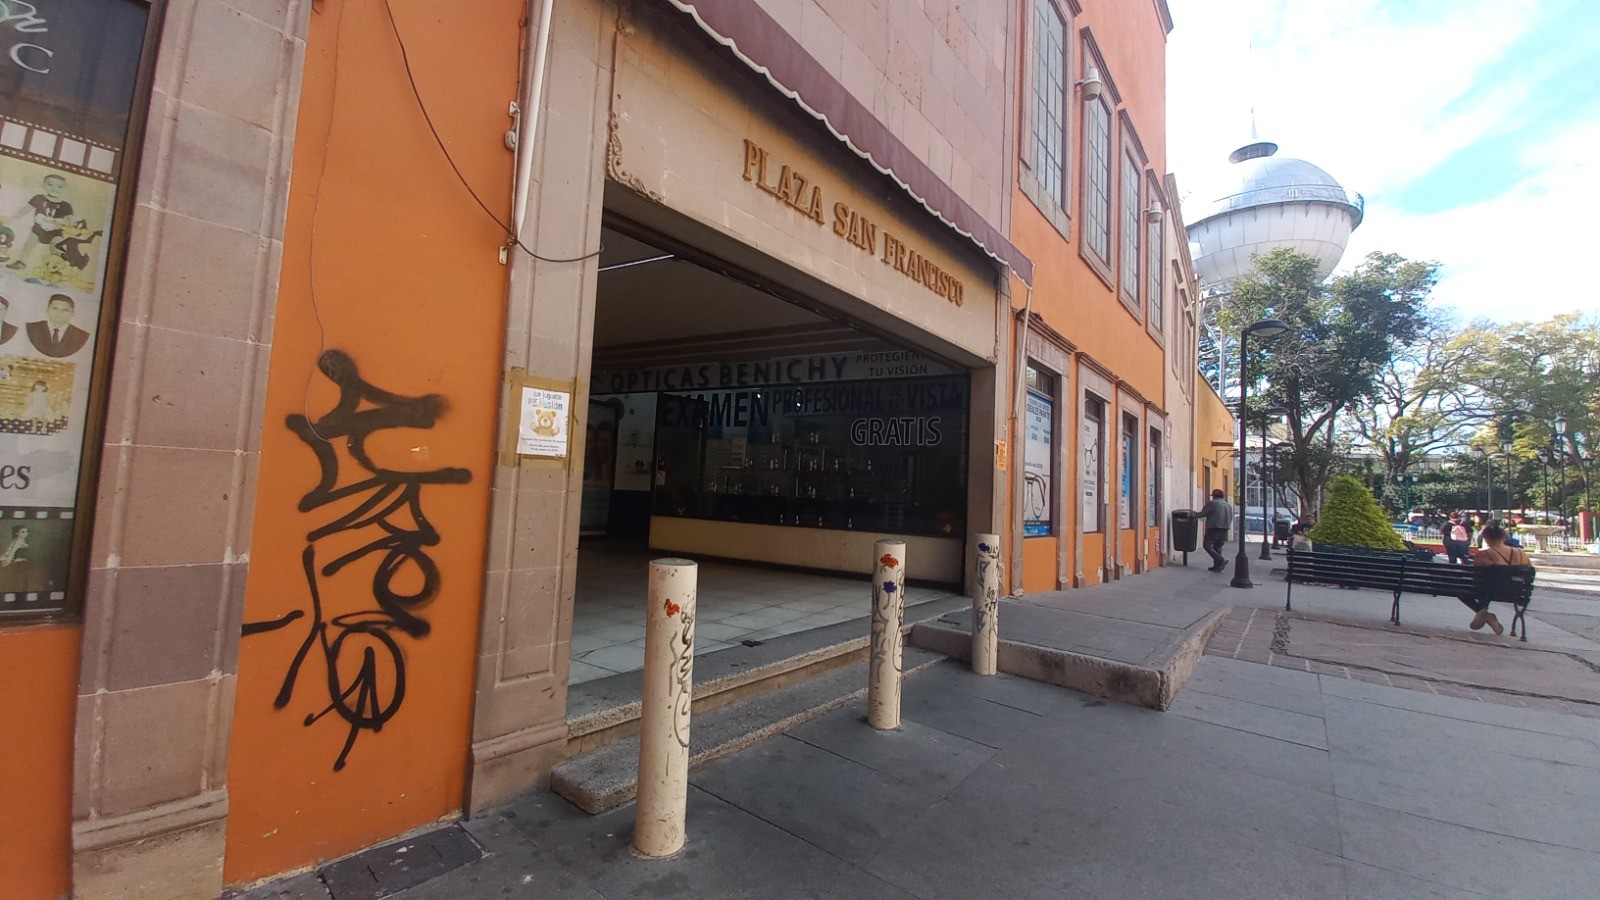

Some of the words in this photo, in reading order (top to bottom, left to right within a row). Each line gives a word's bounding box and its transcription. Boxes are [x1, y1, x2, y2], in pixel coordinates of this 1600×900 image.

[10, 43, 54, 74] C
[742, 138, 825, 226] PLAZA
[833, 201, 878, 255] SAN
[880, 231, 964, 307] FRANCISCO
[856, 351, 922, 364] PROTEGIEN
[868, 367, 884, 377] TU
[610, 365, 711, 391] OPTICAS
[719, 355, 848, 385] BENICHY
[661, 390, 770, 428] EXAMEN
[772, 384, 888, 415] PROFESIONAL
[906, 382, 963, 410] VISTA
[850, 416, 943, 446] GRATIS
[0, 465, 31, 490] es
